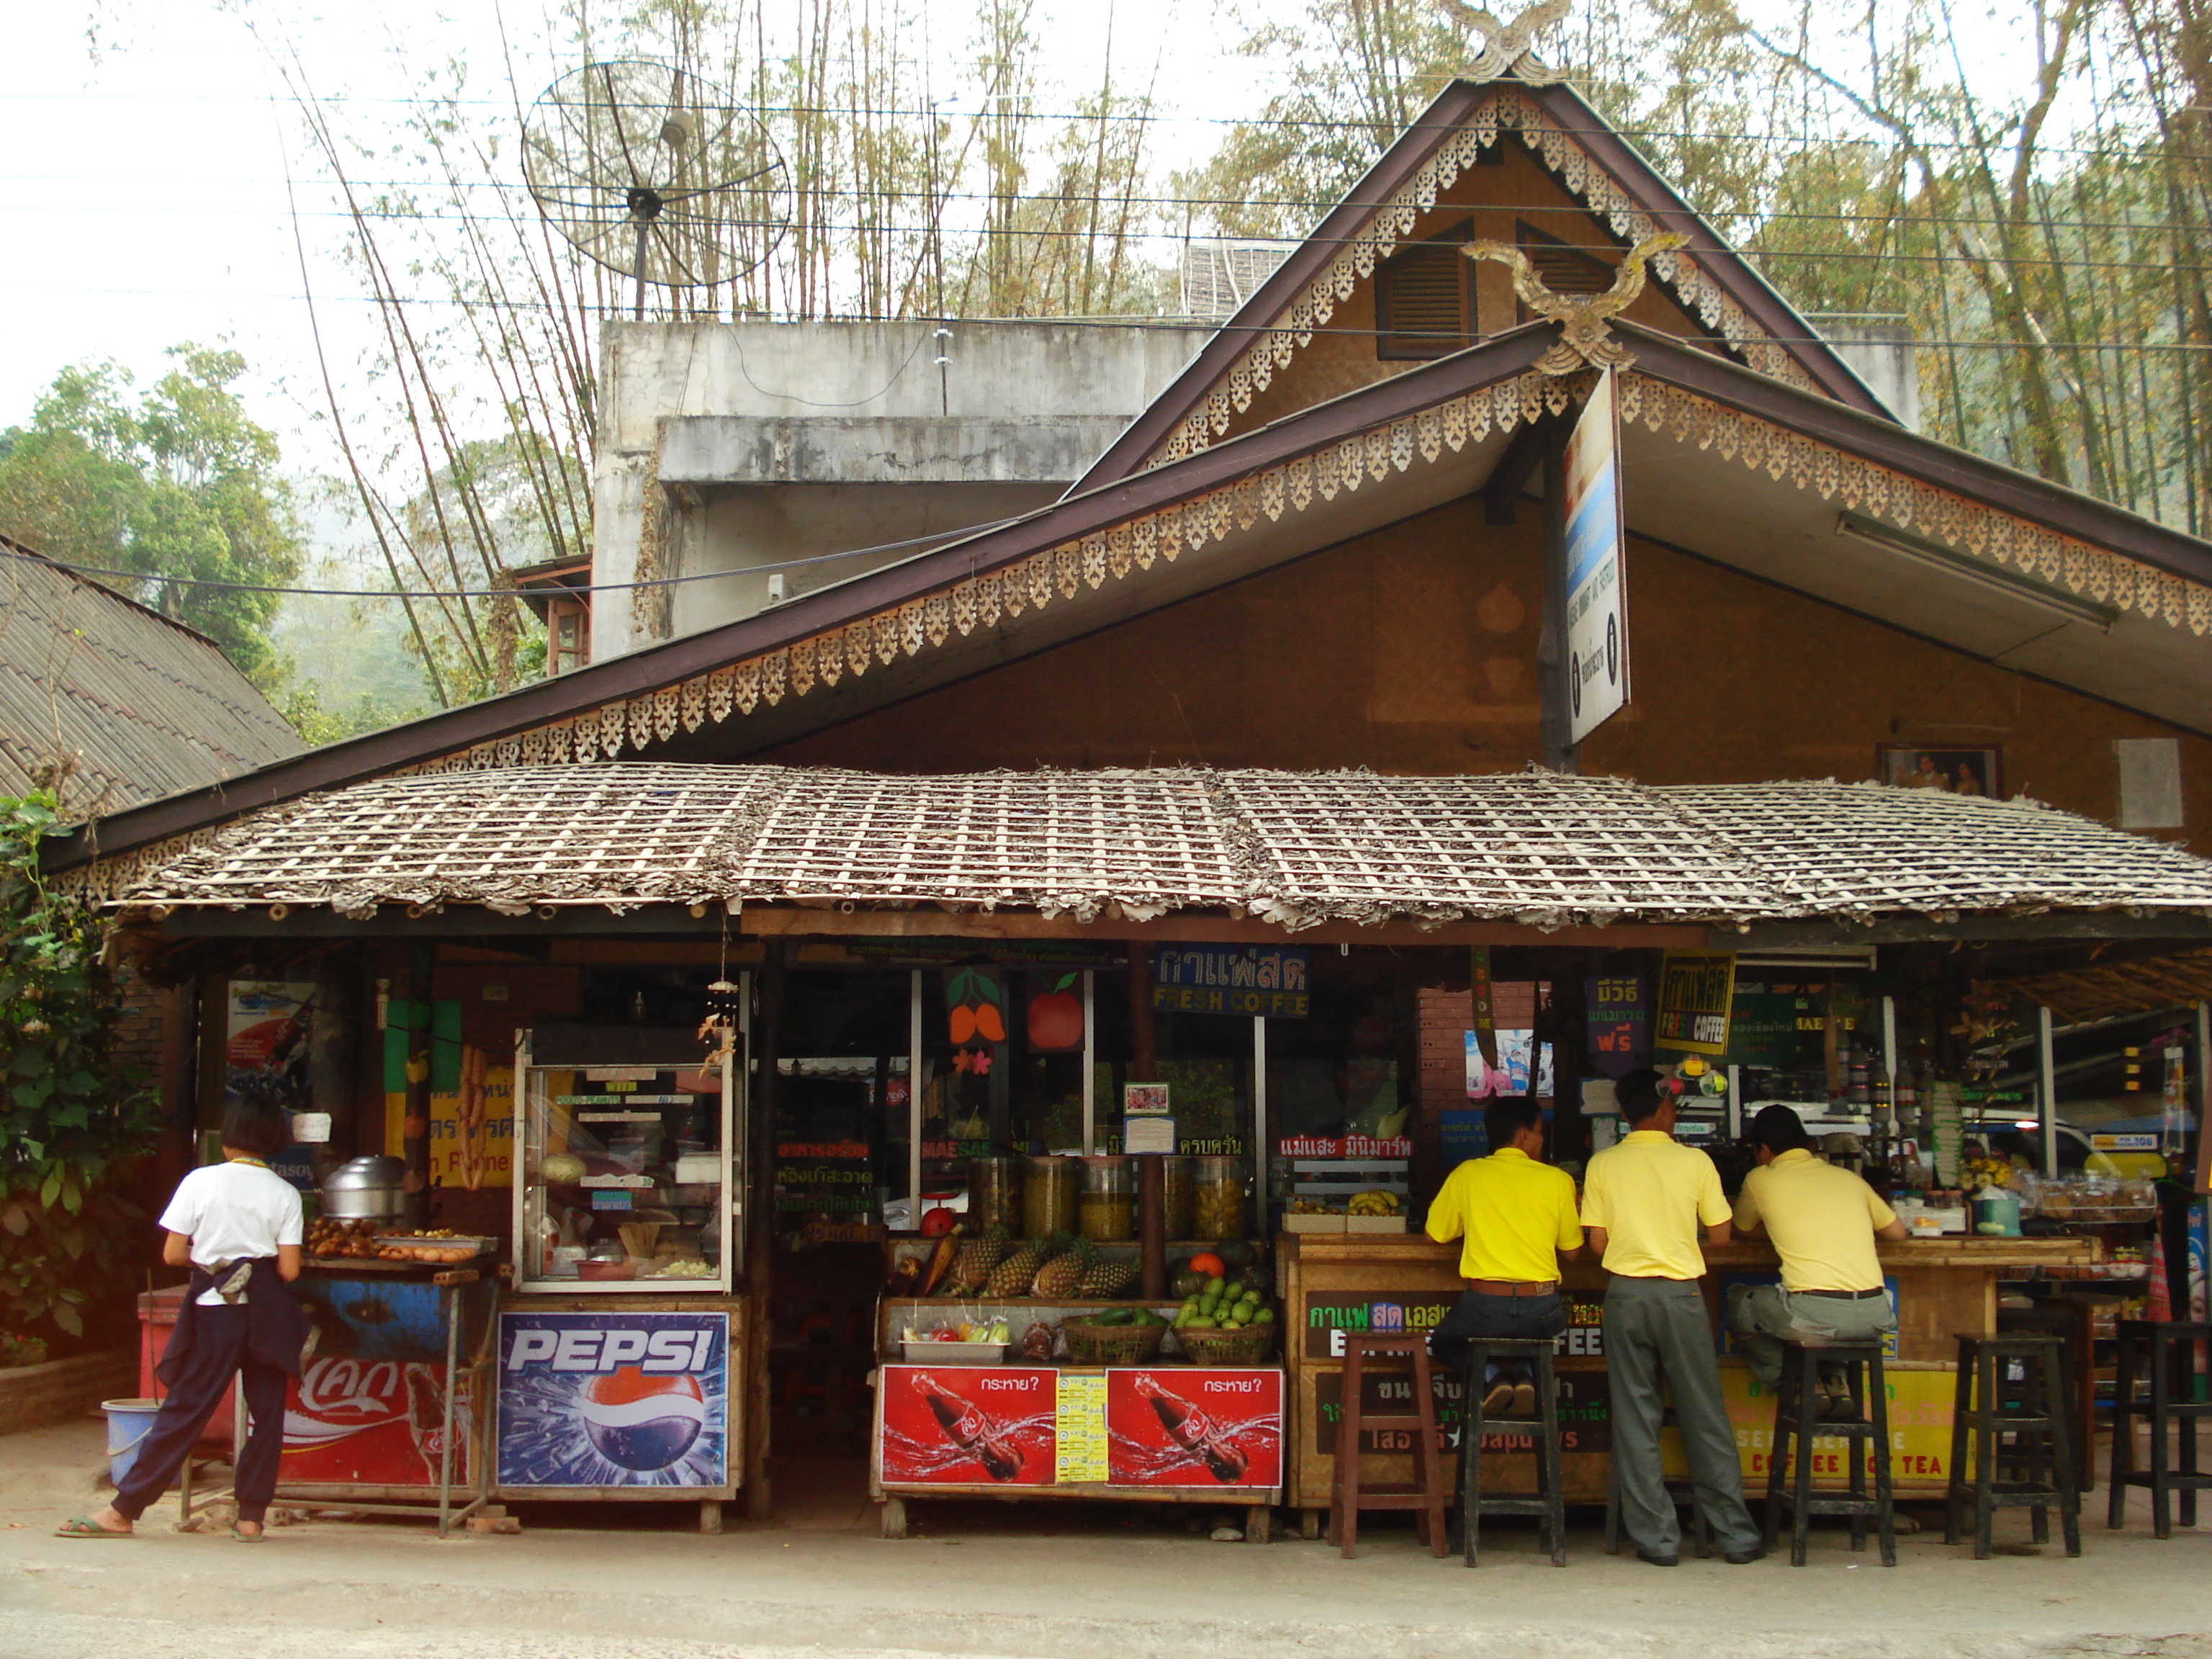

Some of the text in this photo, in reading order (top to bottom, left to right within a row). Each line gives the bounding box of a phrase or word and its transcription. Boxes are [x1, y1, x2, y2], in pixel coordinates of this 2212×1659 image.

[1159, 948, 1305, 991] กาแฟสด
[1597, 978, 1638, 1002] มีวิธี
[1154, 988, 1309, 1016] FRESH COFFEE
[1597, 1023, 1632, 1052] ฟรี
[1694, 1015, 1725, 1043] COFFEE
[777, 1138, 869, 1158] อาหารอร่อย
[1281, 1134, 1411, 1156] แม่แสะ มินิมาร์ท
[777, 1165, 873, 1184] ห้องน้ำสะอาด
[507, 1329, 714, 1372] PEPSI
[981, 1376, 1039, 1391] กระหาย?
[1204, 1378, 1263, 1393] กระหาย?
[1902, 1456, 1942, 1474] TEA
